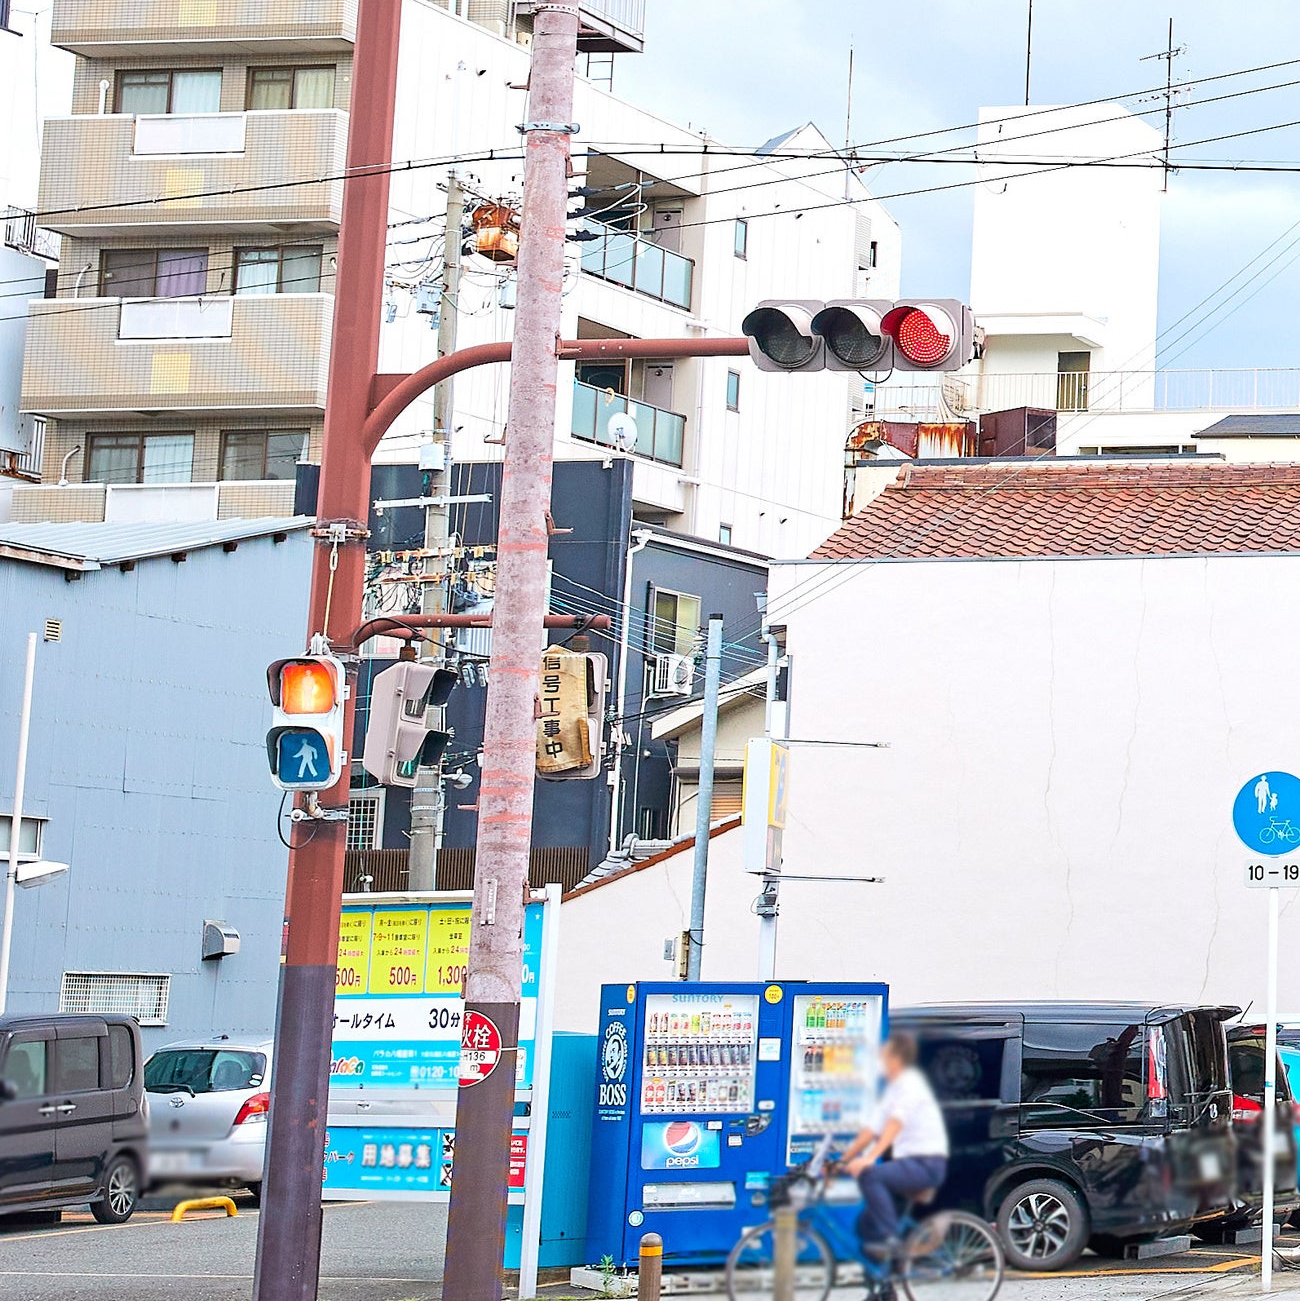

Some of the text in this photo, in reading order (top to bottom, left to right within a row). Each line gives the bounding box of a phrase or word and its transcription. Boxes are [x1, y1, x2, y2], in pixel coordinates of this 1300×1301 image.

[542, 656, 563, 758] 信号工事中
[389, 966, 417, 986] 500円
[428, 1008, 461, 1029] 30分
[598, 1083, 627, 1106] BOSS
[665, 1155, 699, 1168] pepsi
